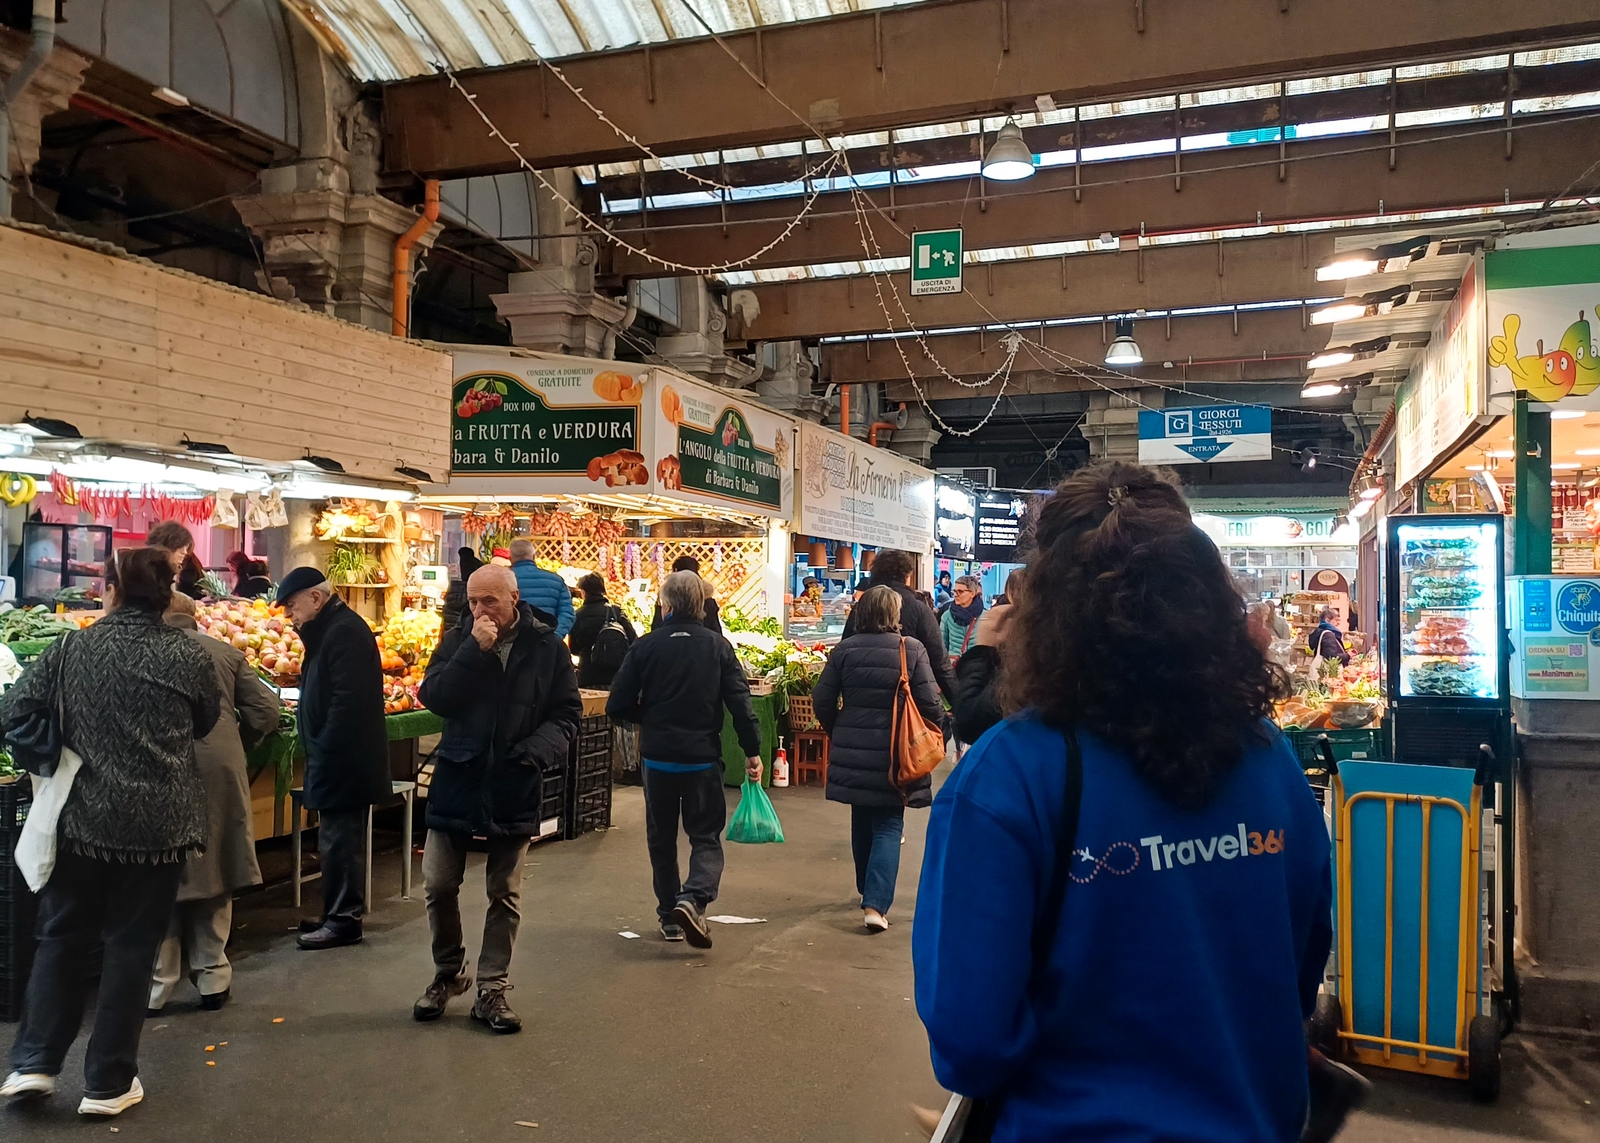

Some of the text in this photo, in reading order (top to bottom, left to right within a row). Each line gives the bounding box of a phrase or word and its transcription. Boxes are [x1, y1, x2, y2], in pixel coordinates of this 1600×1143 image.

[538, 377, 582, 388] GRATUITE
[503, 402, 536, 412] BOX 108
[1198, 409, 1240, 420] GIORGI
[688, 407, 711, 425] GRATUITE
[1173, 418, 1185, 430] G
[468, 424, 532, 440] FRUTTA
[538, 429, 547, 440] e
[552, 422, 632, 439] VERDURA
[1198, 419, 1242, 430] TESSUTI
[452, 448, 560, 464] bara & Danilo
[1188, 445, 1221, 453] ENTRATA
[679, 438, 780, 480] L'ANGOLO della FRUTTA e VERDURA
[706, 468, 759, 495] di Barbara & Danilo
[860, 457, 897, 502] Forneria
[1140, 823, 1285, 871] Travel36
